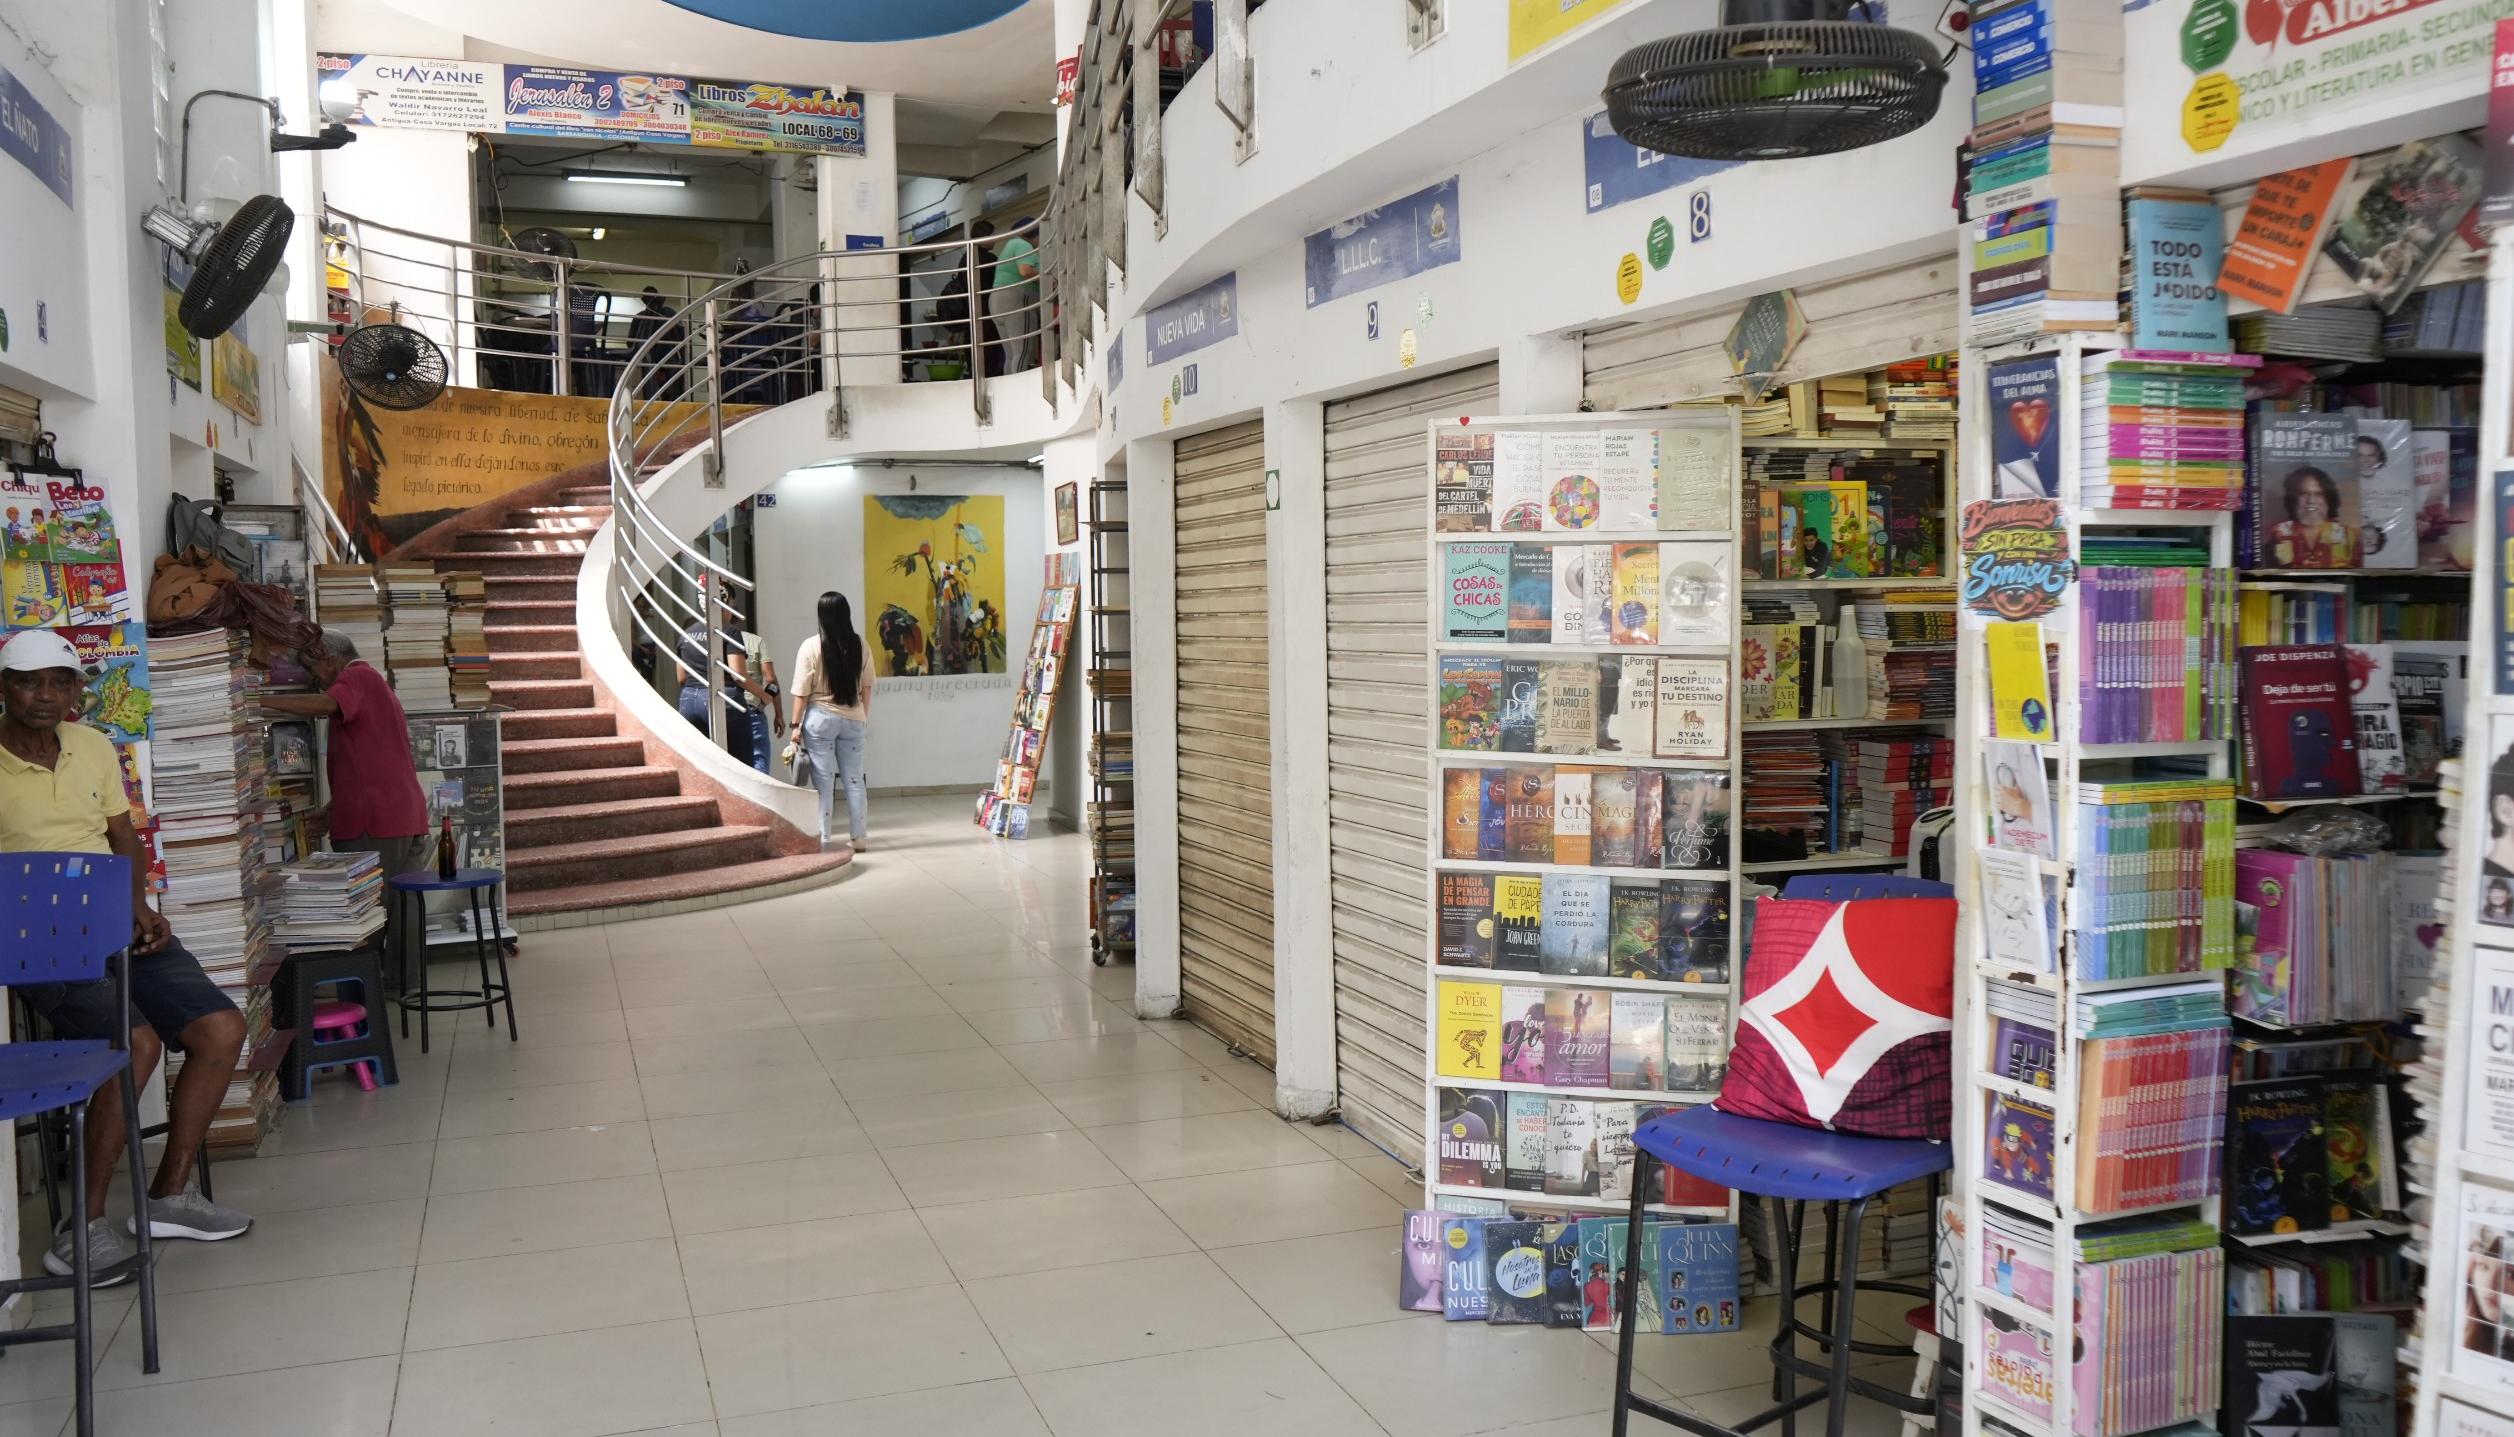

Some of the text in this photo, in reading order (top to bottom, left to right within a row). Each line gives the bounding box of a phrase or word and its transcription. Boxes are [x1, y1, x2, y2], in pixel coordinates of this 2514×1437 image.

[318, 57, 350, 70] 2 piso
[376, 66, 484, 83] CHAYANNE
[2294, 60, 2405, 110] LITERATURA
[2411, 49, 2436, 77] EN
[657, 77, 686, 90] 2 piso
[507, 77, 613, 114] Jerusalén 2
[698, 85, 746, 103] Libros
[424, 104, 463, 112] Navarro
[673, 103, 684, 115] 71
[695, 130, 721, 141] 2 piso
[782, 122, 858, 140] LOCAL 68 69
[1692, 191, 1710, 238] 8
[2151, 240, 2202, 258] TODO
[2153, 259, 2194, 278] ESTÁ
[1368, 305, 1377, 337] 9
[1157, 309, 1205, 347] NUEVA VIDA
[1184, 366, 1195, 392] 10
[402, 424, 461, 443] mensajera
[2262, 430, 2357, 451] ROMPERME
[1473, 465, 1491, 476] VIDA
[1439, 490, 1479, 501] DEL CARTEL
[1983, 532, 2009, 547] SIN
[1451, 546, 1507, 554] KAZ COOKE
[1964, 553, 2066, 601] Sonrisa
[1453, 576, 1496, 591] COSAS
[1453, 592, 1501, 606] CHICAS
[76, 634, 99, 644] Atlas
[97, 639, 109, 648] de
[1624, 657, 1644, 667] ¿Por
[2254, 651, 2336, 662] JOE DISPENZA
[1507, 665, 1525, 673] ERIC
[1661, 676, 1722, 685] DISCIPLINA
[1553, 687, 1561, 696] EL
[1632, 690, 1643, 698] es
[2262, 684, 2289, 696] Deja
[2290, 683, 2305, 694] de
[1554, 698, 1590, 708] NARIO DE
[1661, 693, 1723, 702] TU DESTINO
[1552, 708, 1590, 718] LA PUERTA
[1551, 719, 1590, 729] DE AL LADO
[1443, 877, 1483, 886] LA MAGIA
[1443, 887, 1489, 897] DE PENSAR
[1443, 897, 1490, 907] EN GRANDE
[1556, 920, 1594, 928] CORDURA
[1505, 930, 1522, 944] JOHN
[1455, 995, 1488, 1007] DYER
[1563, 1027, 1572, 1042] 5
[1559, 1041, 1606, 1055] amor
[1555, 1076, 1608, 1085] Gary Chapman
[1560, 1104, 1579, 1114] P.D.
[1607, 1117, 1628, 1127] Para
[1564, 1129, 1573, 1139] te
[1441, 1141, 1502, 1162] DILEMMA
[1554, 1143, 1582, 1154] quiero
[1482, 1161, 1489, 1169] IS
[1444, 1202, 1497, 1215] HISTORIA
[1677, 1229, 1721, 1246] JULIA
[1668, 1243, 1733, 1264] QUINN
